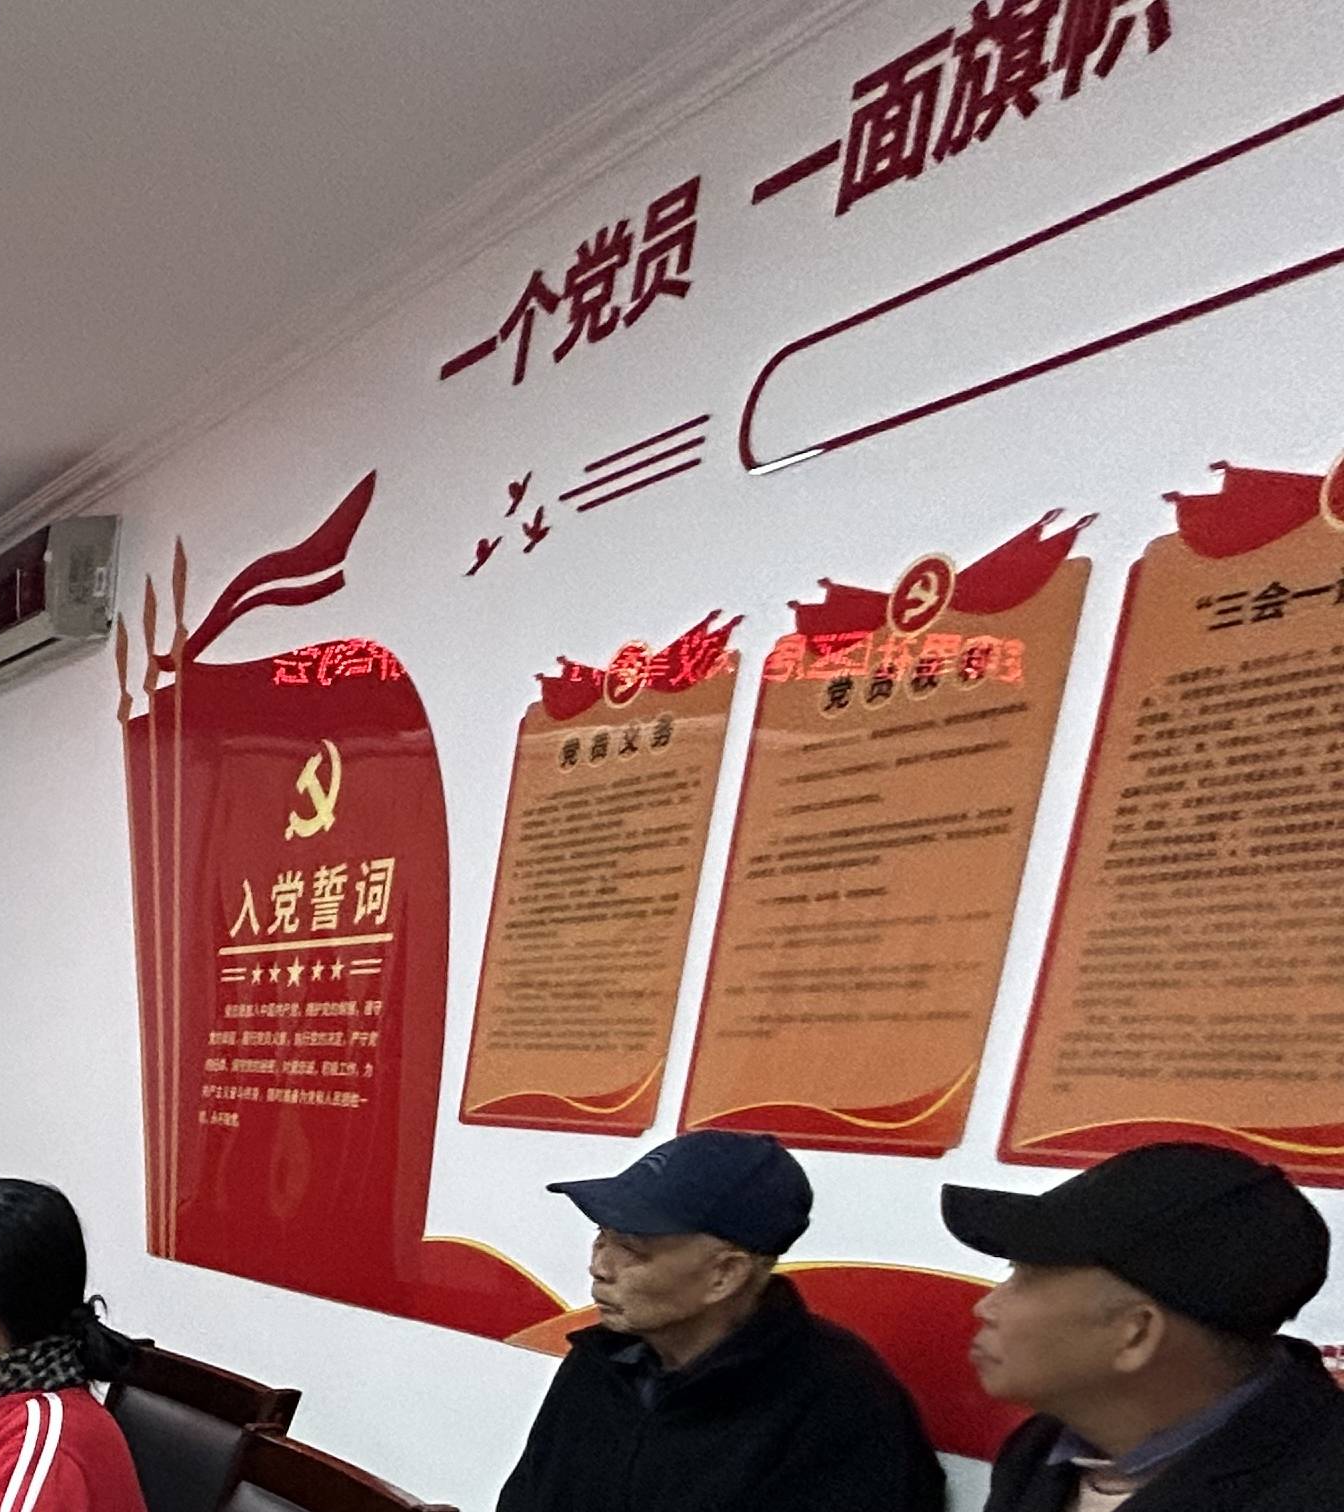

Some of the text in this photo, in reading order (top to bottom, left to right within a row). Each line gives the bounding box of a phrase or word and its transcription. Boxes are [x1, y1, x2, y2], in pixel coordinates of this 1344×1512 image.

[440, 175, 701, 385] 一个党员
[229, 857, 396, 938] 入党誓词
